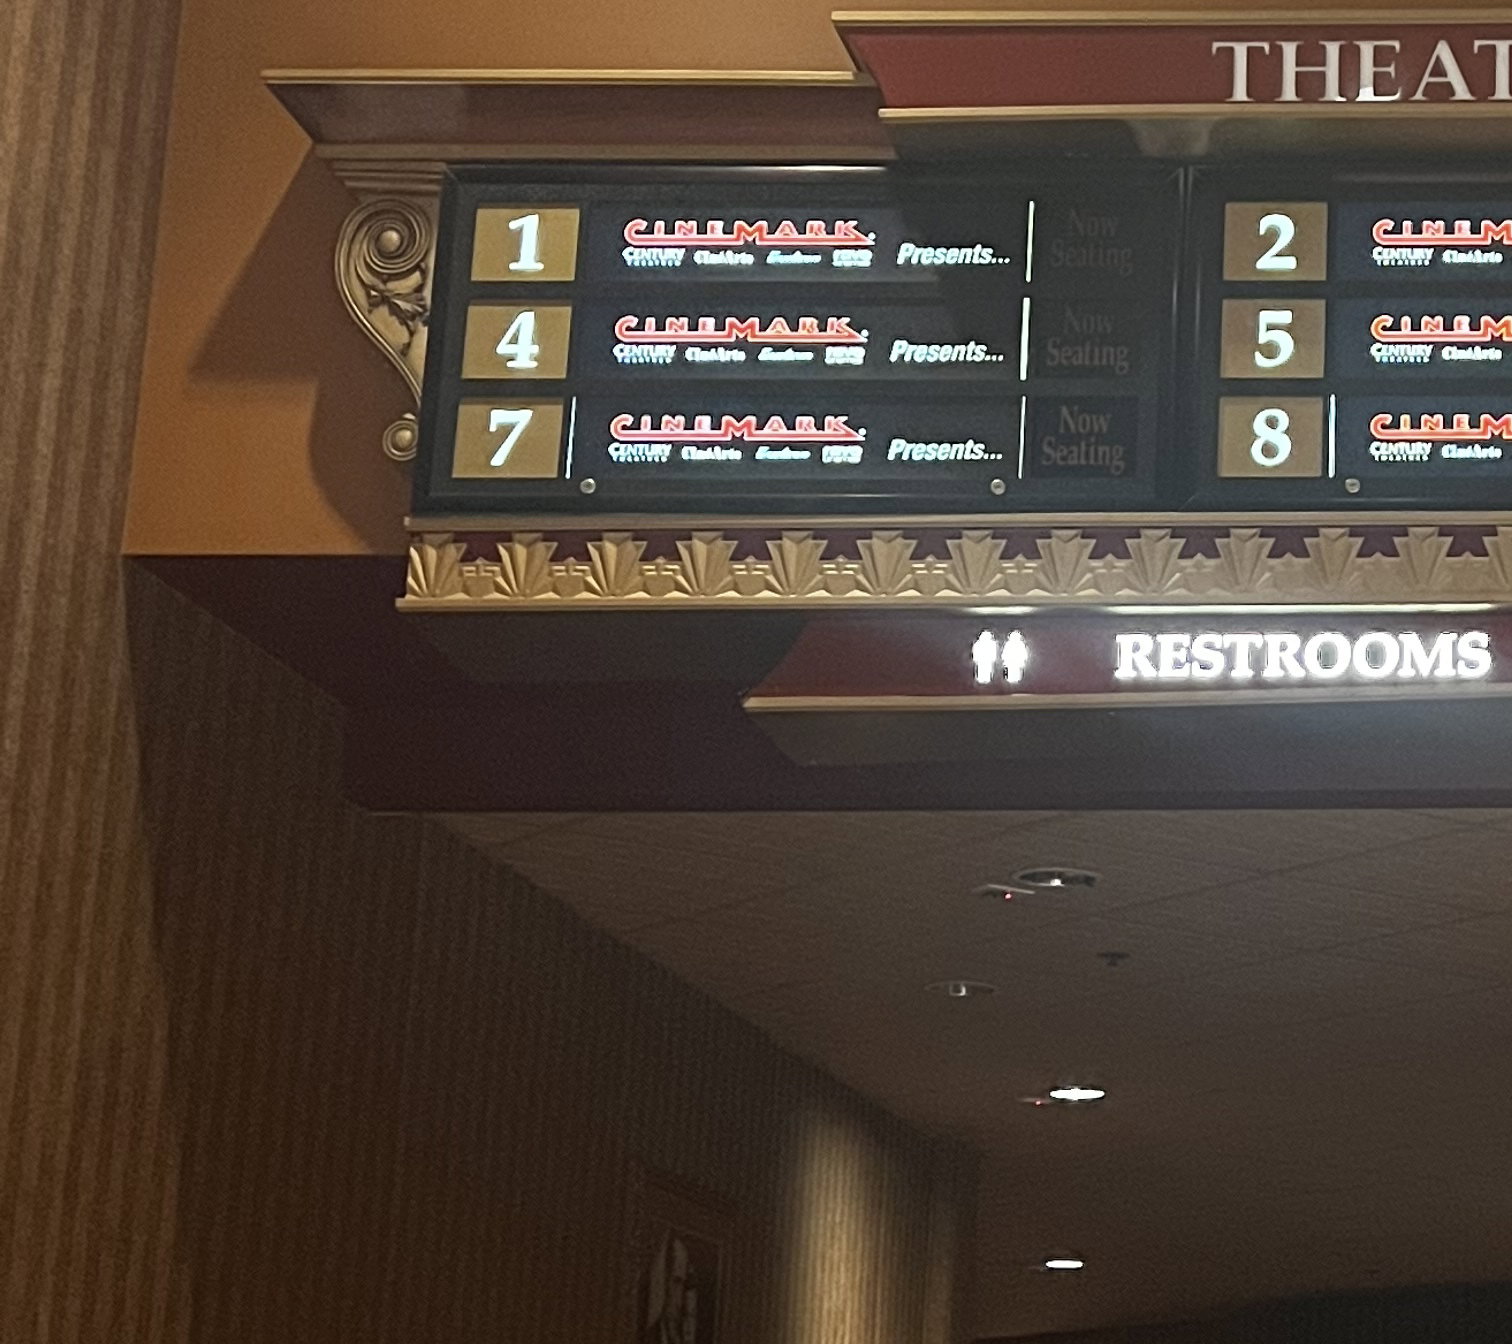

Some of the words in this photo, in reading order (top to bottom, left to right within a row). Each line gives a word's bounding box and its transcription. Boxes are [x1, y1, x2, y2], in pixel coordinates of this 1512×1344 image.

[509, 214, 544, 271] 1
[624, 219, 868, 246] CINEMARK
[1256, 214, 1296, 269] 2
[497, 312, 539, 368] 4
[615, 315, 859, 343] CINEMARK
[1255, 311, 1293, 367] 5
[490, 410, 533, 466] 7
[610, 414, 853, 441] CINEMARK
[1059, 406, 1111, 434] Now
[1251, 409, 1291, 466] 8
[1041, 436, 1125, 475] Seating
[1115, 631, 1492, 680] RESTROOMS
